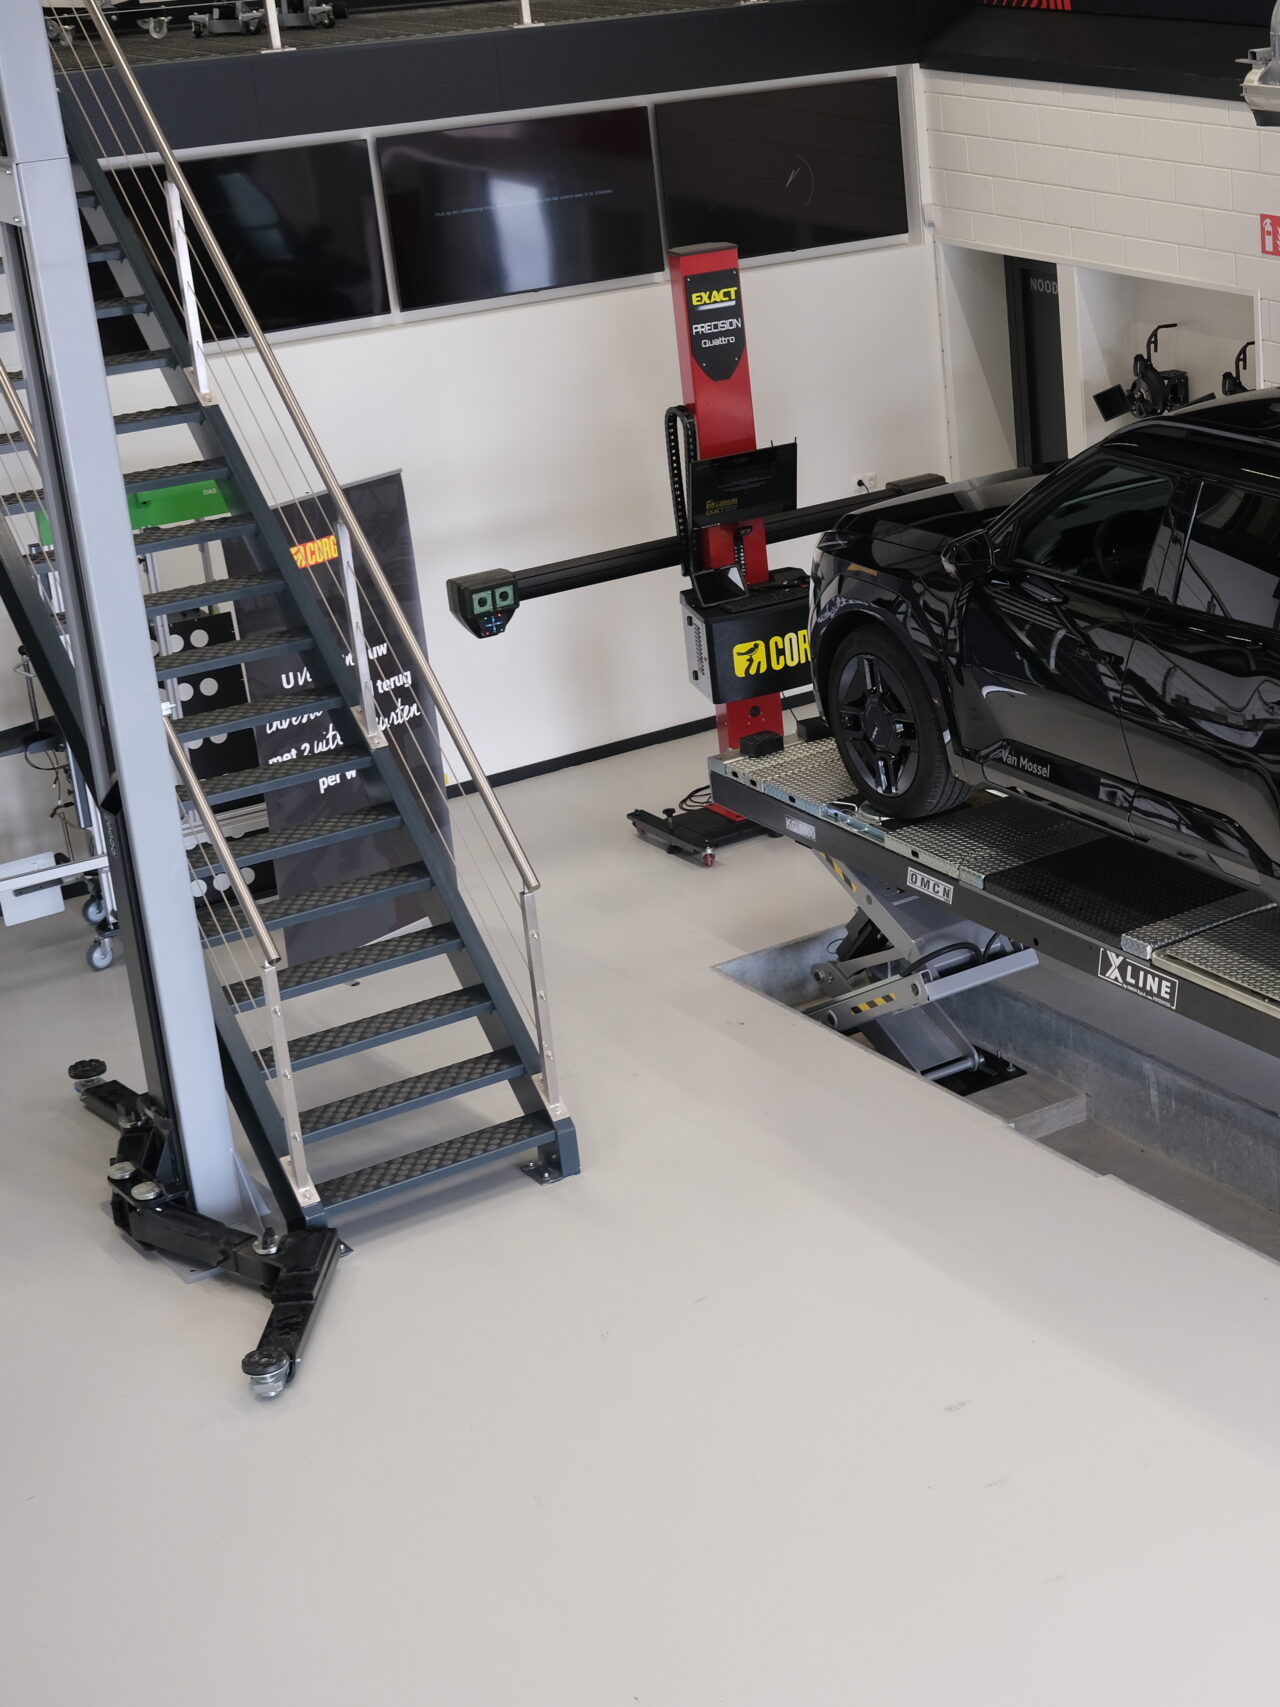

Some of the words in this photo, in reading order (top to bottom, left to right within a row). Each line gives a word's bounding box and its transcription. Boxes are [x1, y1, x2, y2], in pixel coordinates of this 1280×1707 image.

[691, 286, 738, 306] EXACT
[1030, 277, 1058, 295] NOOD
[692, 316, 742, 336] PRECISION
[701, 336, 736, 348] Quattro
[769, 629, 811, 671] COR
[376, 670, 412, 694] terug
[1002, 746, 1017, 766] Van
[1020, 755, 1050, 778] Mossel
[910, 872, 950, 899] OMCN
